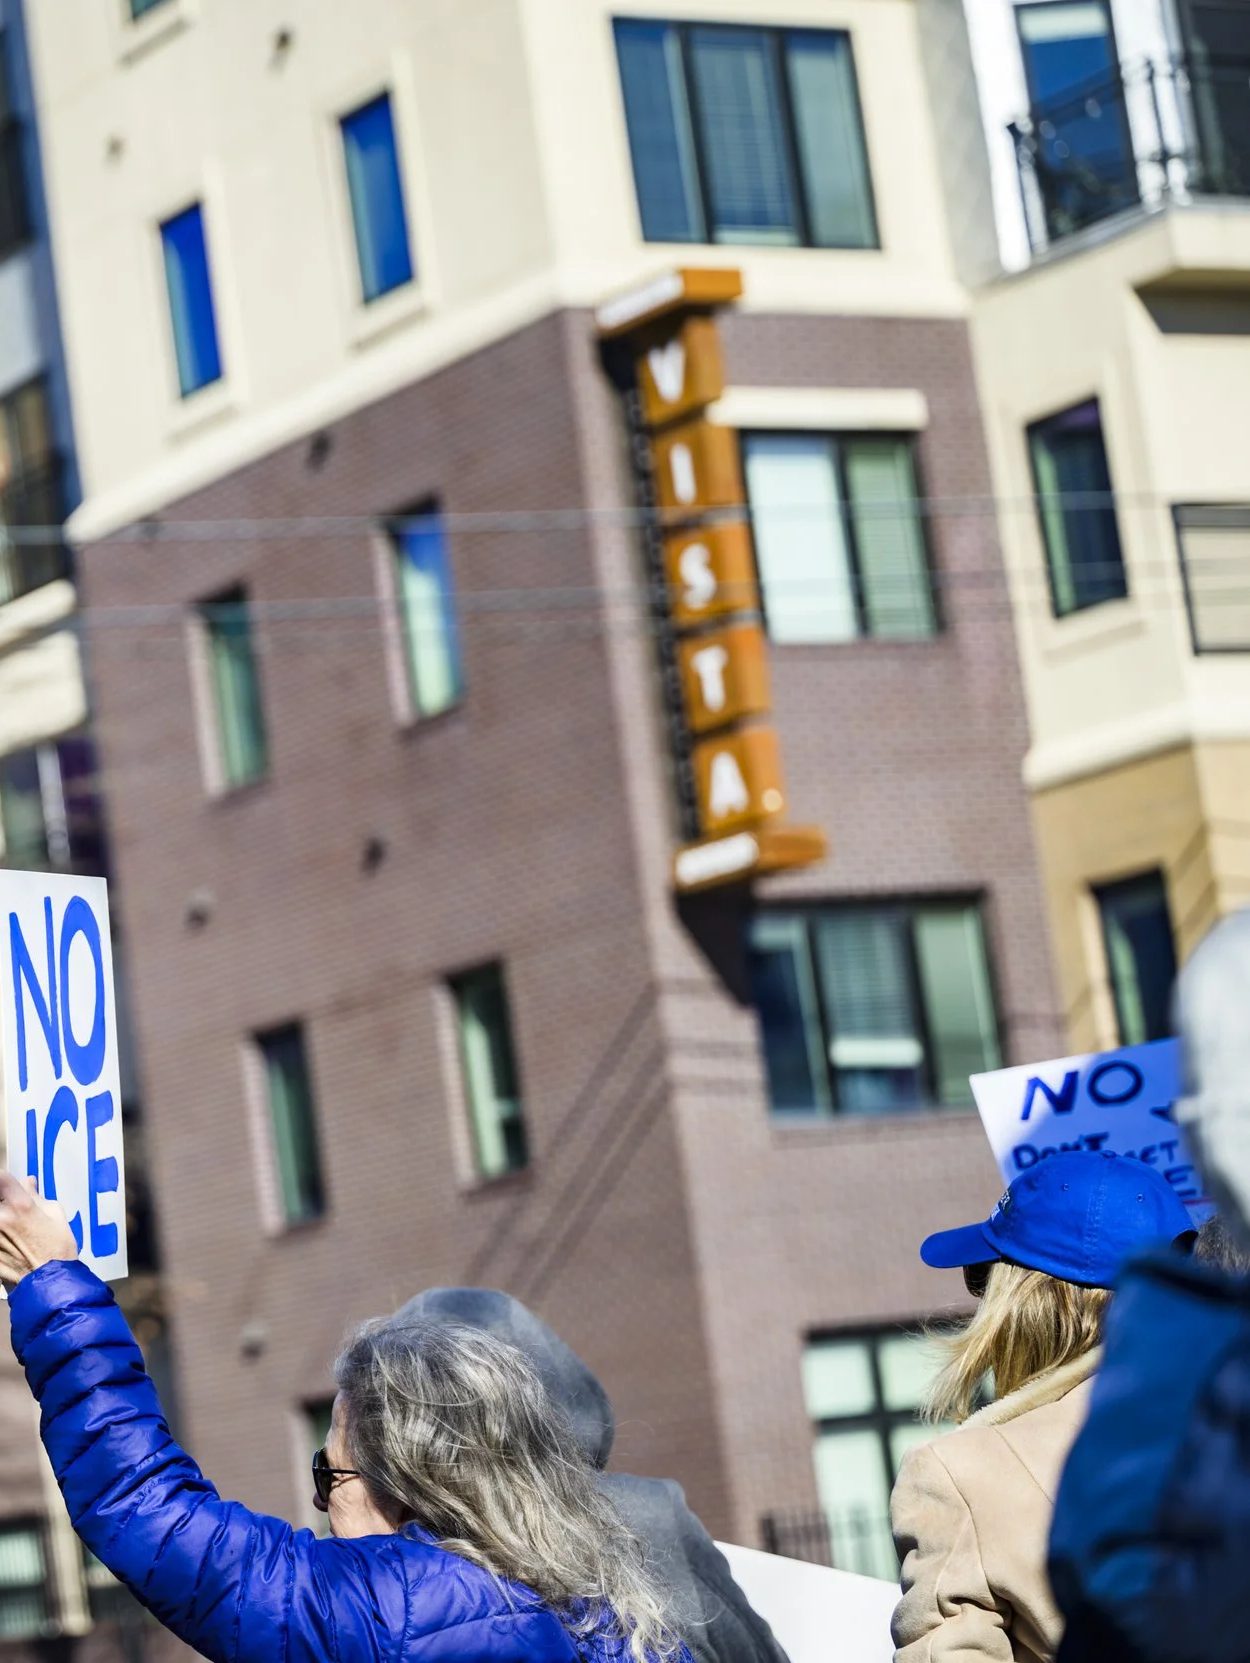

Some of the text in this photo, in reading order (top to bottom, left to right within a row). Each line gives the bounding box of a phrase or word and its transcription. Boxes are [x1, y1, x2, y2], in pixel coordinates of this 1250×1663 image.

[649, 339, 748, 818] VISTA
[9, 895, 106, 1092] NO
[26, 1086, 119, 1257] ICE
[1021, 1060, 1144, 1121] NO
